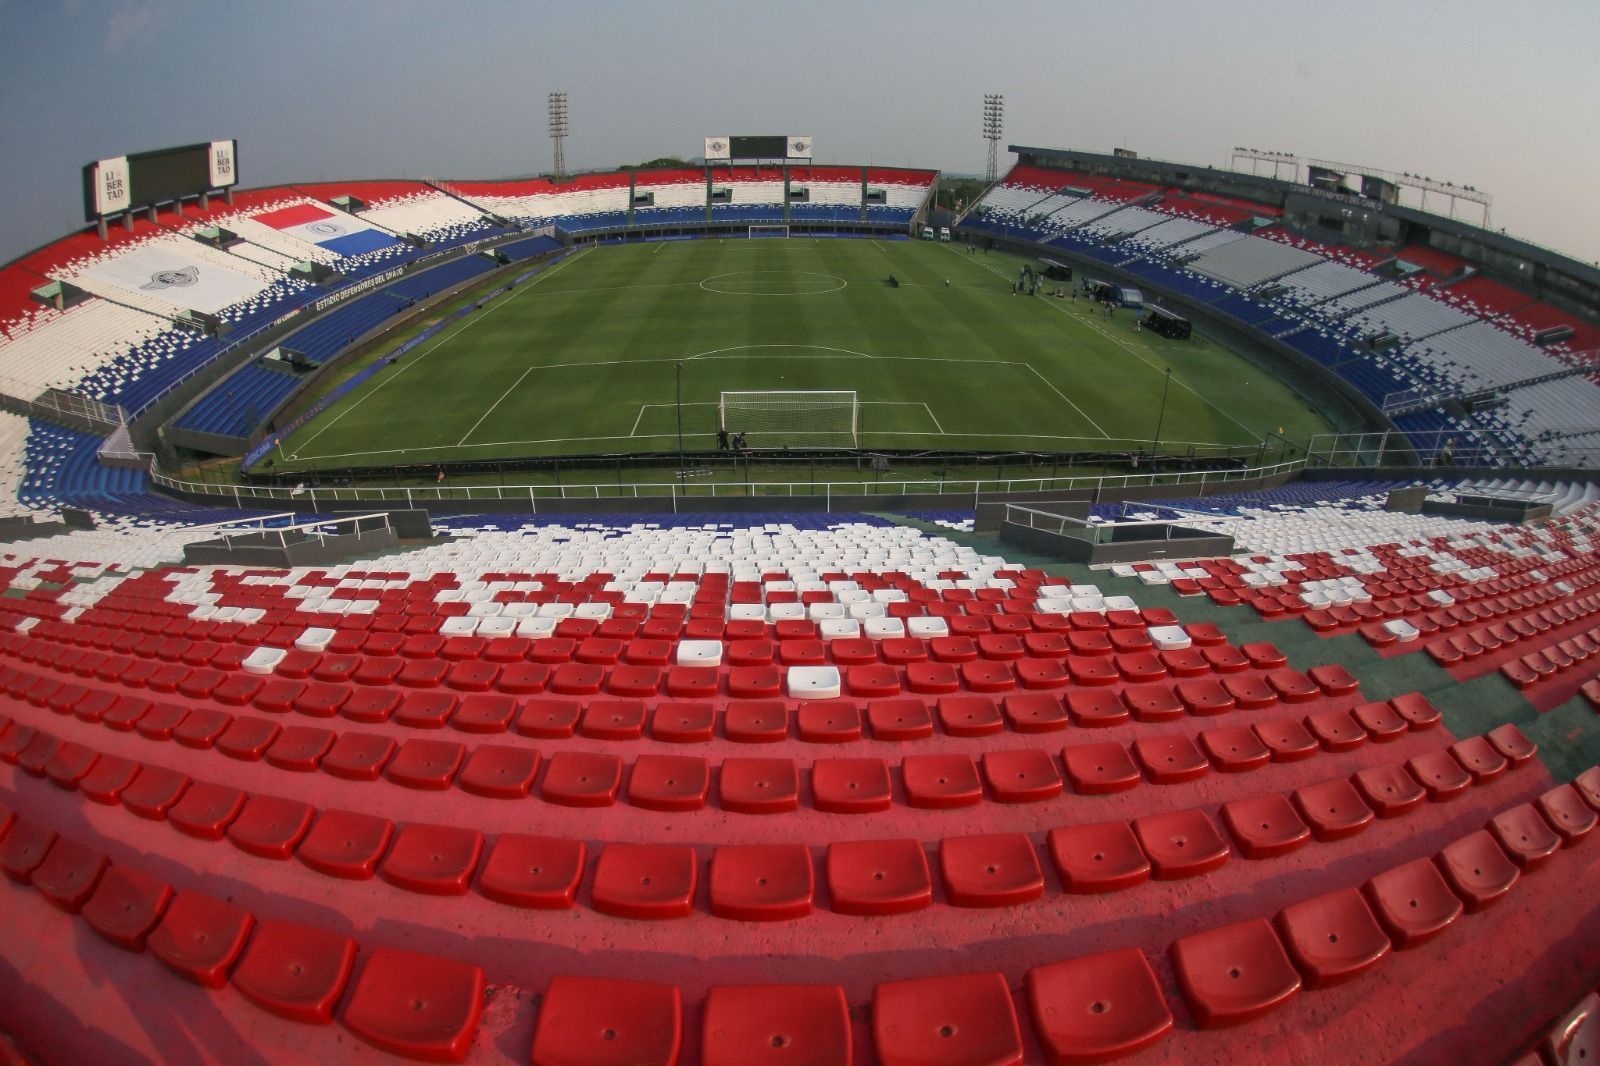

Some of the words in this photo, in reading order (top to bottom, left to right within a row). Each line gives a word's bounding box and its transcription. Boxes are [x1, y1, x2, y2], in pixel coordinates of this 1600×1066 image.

[217, 157, 230, 166] BER
[217, 165, 231, 175] TAD
[105, 171, 115, 181] LI
[106, 179, 123, 190] BER
[106, 188, 124, 200] TAD
[315, 292, 340, 311] ESTADIO
[340, 278, 375, 300] DEFENSORES
[374, 274, 385, 285] DEL
